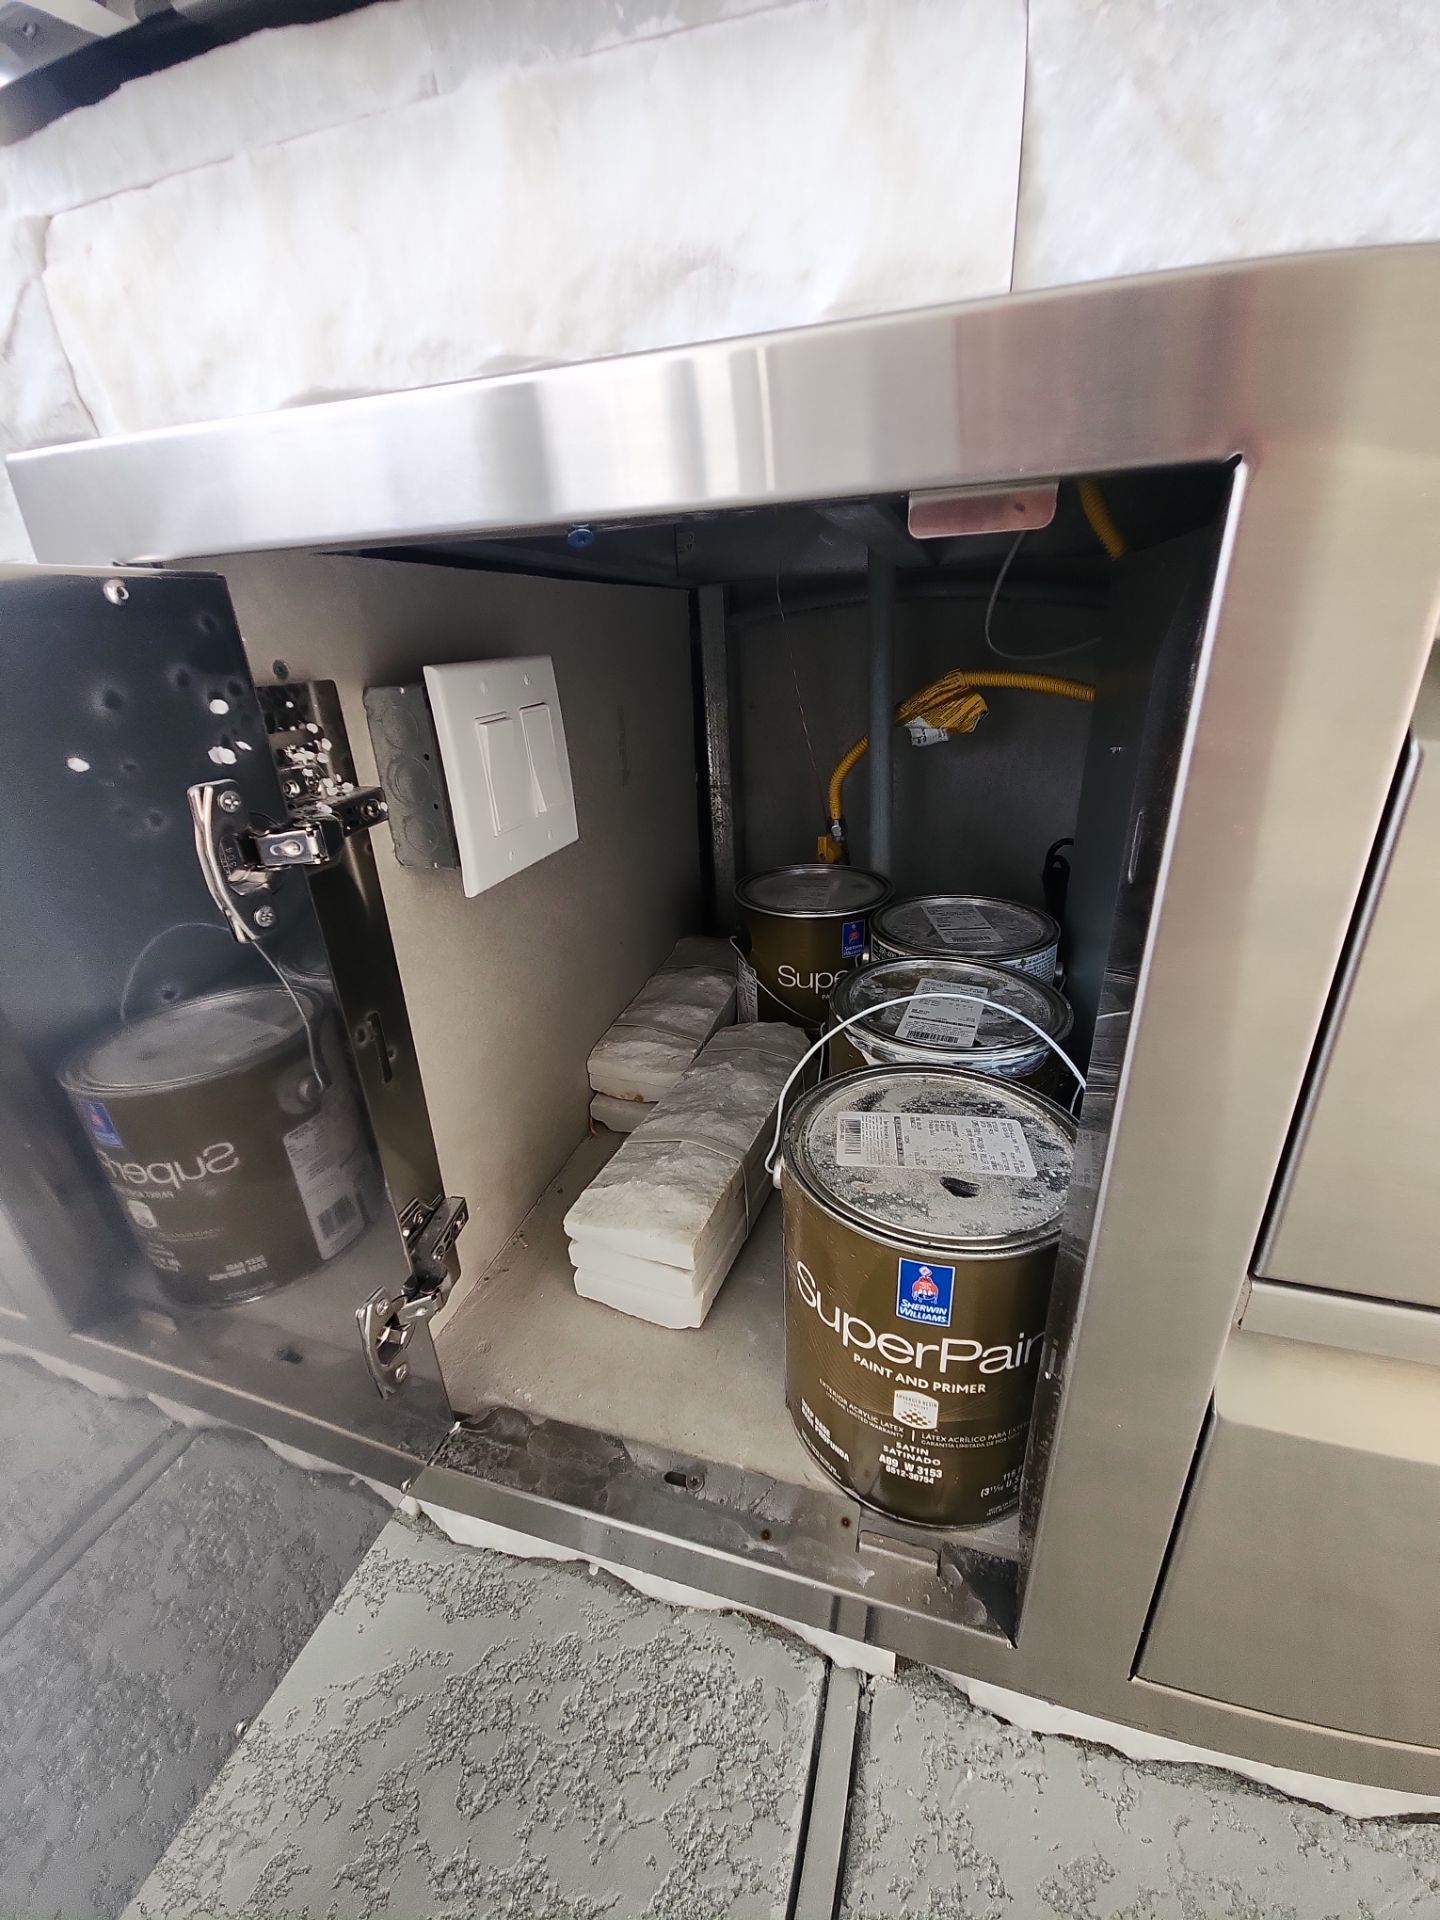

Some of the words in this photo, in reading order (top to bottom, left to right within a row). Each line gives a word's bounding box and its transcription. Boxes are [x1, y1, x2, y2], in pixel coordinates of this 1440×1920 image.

[900, 1306, 947, 1323] WILLIAMS
[901, 1299, 947, 1315] SHERWIN
[854, 1352, 893, 1379] PAINT
[895, 1372, 928, 1389] AND
[933, 1381, 986, 1394] PRIMER
[848, 1403, 879, 1424] ACRYLIC
[880, 1419, 904, 1433] LATEX
[883, 1445, 941, 1466] SATINADO
[895, 1441, 929, 1456] SATIN
[903, 1461, 915, 1472] W
[916, 1465, 943, 1478] 3153
